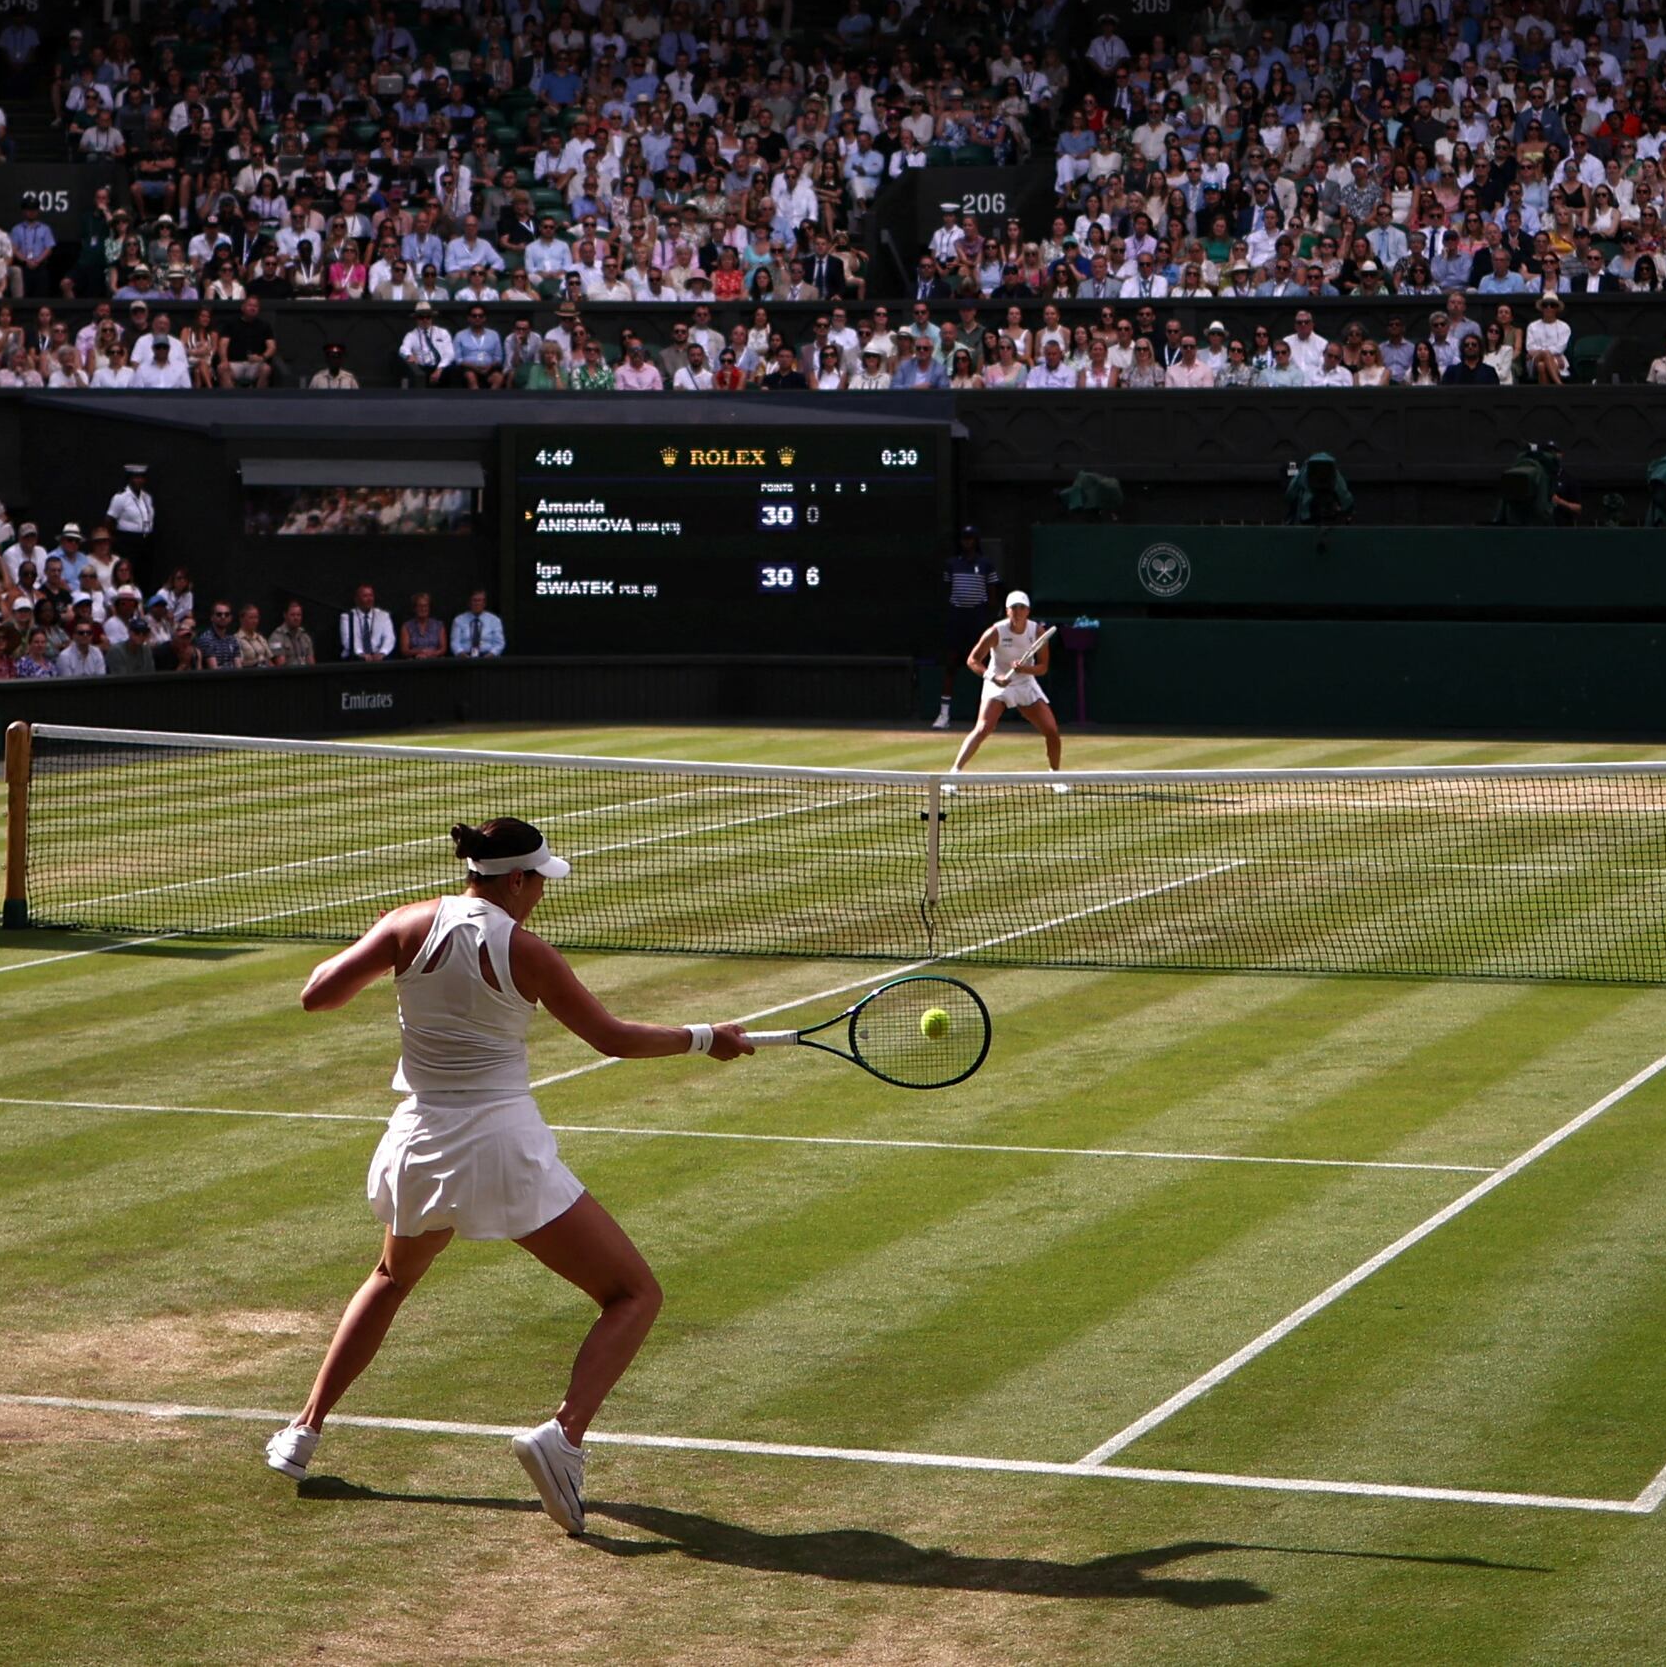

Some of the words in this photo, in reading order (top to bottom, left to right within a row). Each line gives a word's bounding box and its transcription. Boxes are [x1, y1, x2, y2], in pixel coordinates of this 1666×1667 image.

[962, 193, 1006, 214] 206
[535, 449, 574, 466] 4:40
[689, 449, 766, 466] ROLEX
[881, 449, 918, 466] 0:30
[760, 483, 794, 493] POINTS
[835, 483, 842, 493] 2
[860, 483, 867, 493] 3
[536, 498, 605, 514] Amanda
[761, 506, 794, 526] 30
[806, 505, 820, 524] 0
[536, 518, 633, 532] ANISIMOVA
[536, 561, 562, 579] Iga
[761, 567, 794, 587] 30
[806, 566, 820, 586] 6
[536, 581, 614, 595] SWIATEK
[341, 691, 394, 710] Emirates
